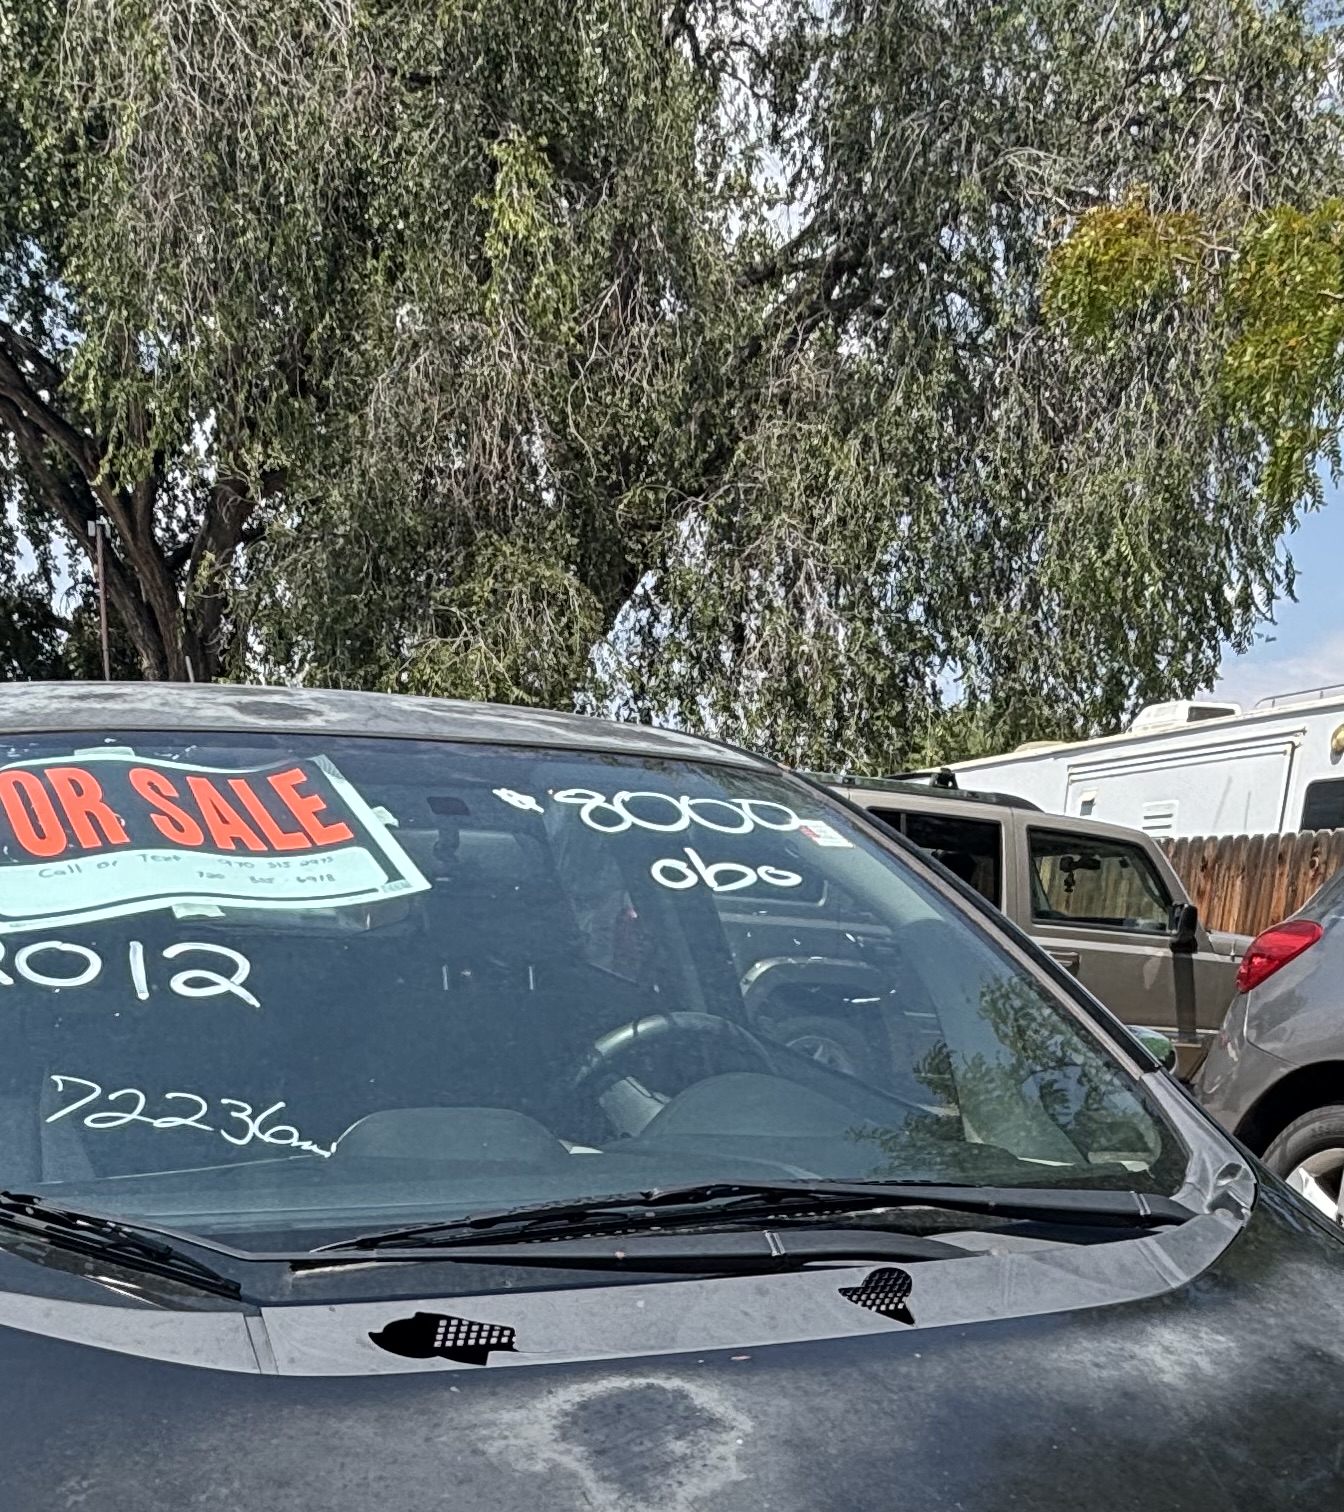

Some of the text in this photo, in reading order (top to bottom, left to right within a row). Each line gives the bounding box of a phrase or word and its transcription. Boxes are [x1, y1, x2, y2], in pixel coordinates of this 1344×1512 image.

[129, 767, 354, 852] SALE
[38, 863, 83, 879] Call
[96, 859, 119, 870] or
[137, 853, 182, 864] Text
[217, 858, 255, 869] 970
[651, 847, 802, 891] obo
